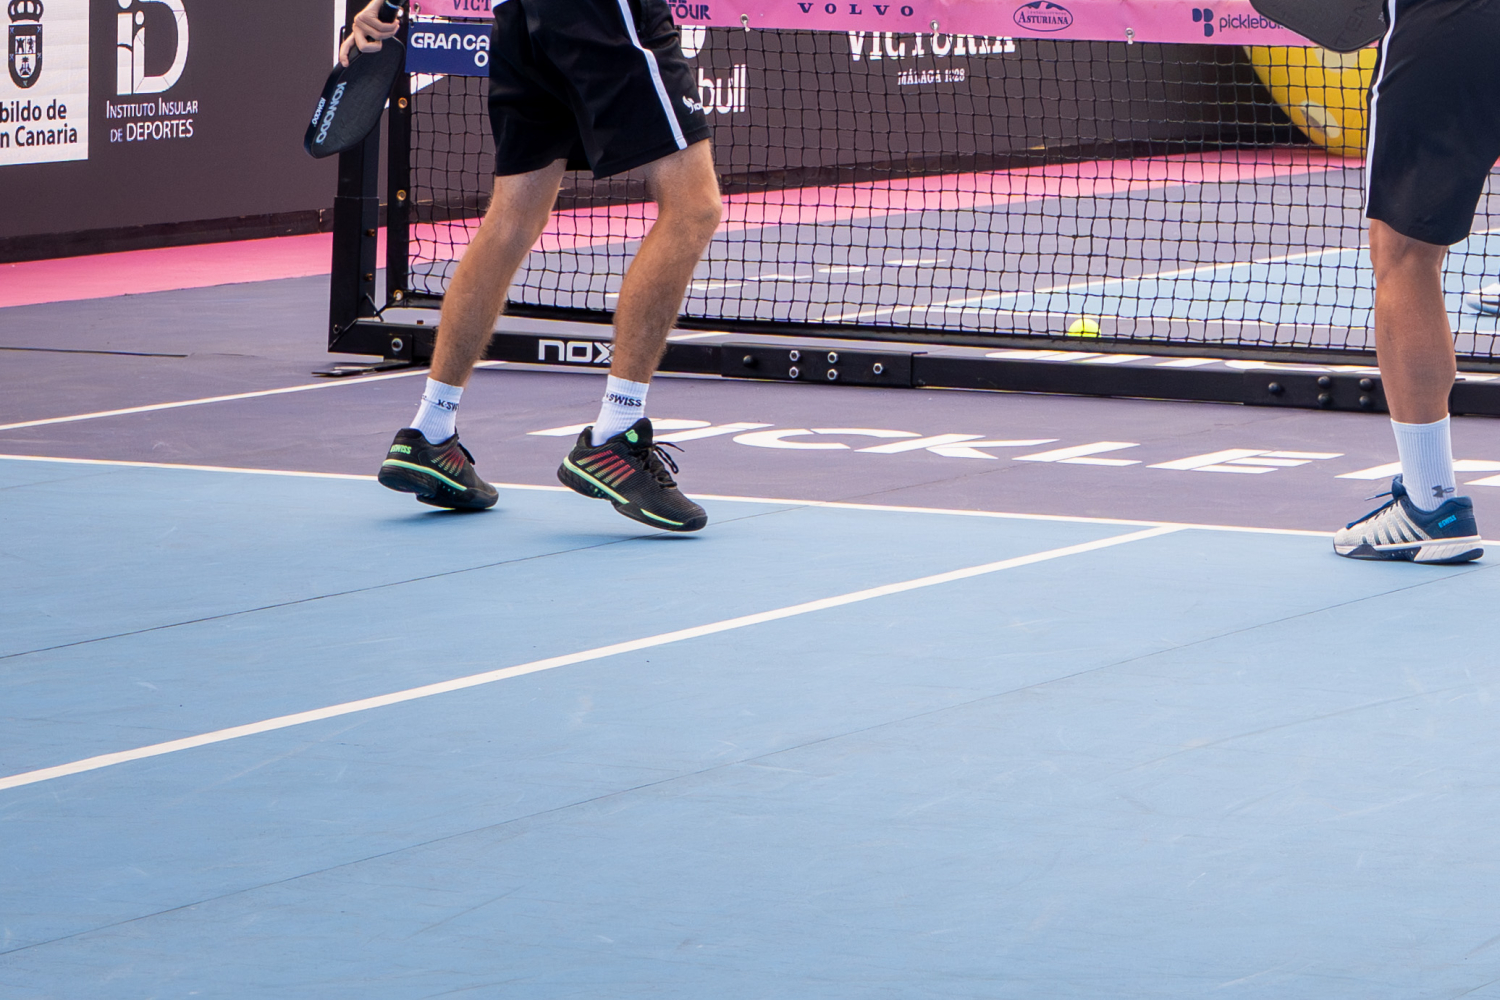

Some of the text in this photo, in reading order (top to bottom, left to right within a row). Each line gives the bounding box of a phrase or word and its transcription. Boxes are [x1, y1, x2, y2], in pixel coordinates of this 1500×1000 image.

[797, 2, 914, 17] VOLVO
[1019, 11, 1069, 25] ASTURIANA
[1219, 14, 1284, 32] picklebu
[411, 32, 461, 50] GRAN
[0, 98, 67, 123] bildo de
[316, 81, 347, 145] KOMODO
[15, 123, 77, 147] Canaria
[126, 119, 194, 142] DEPORTES
